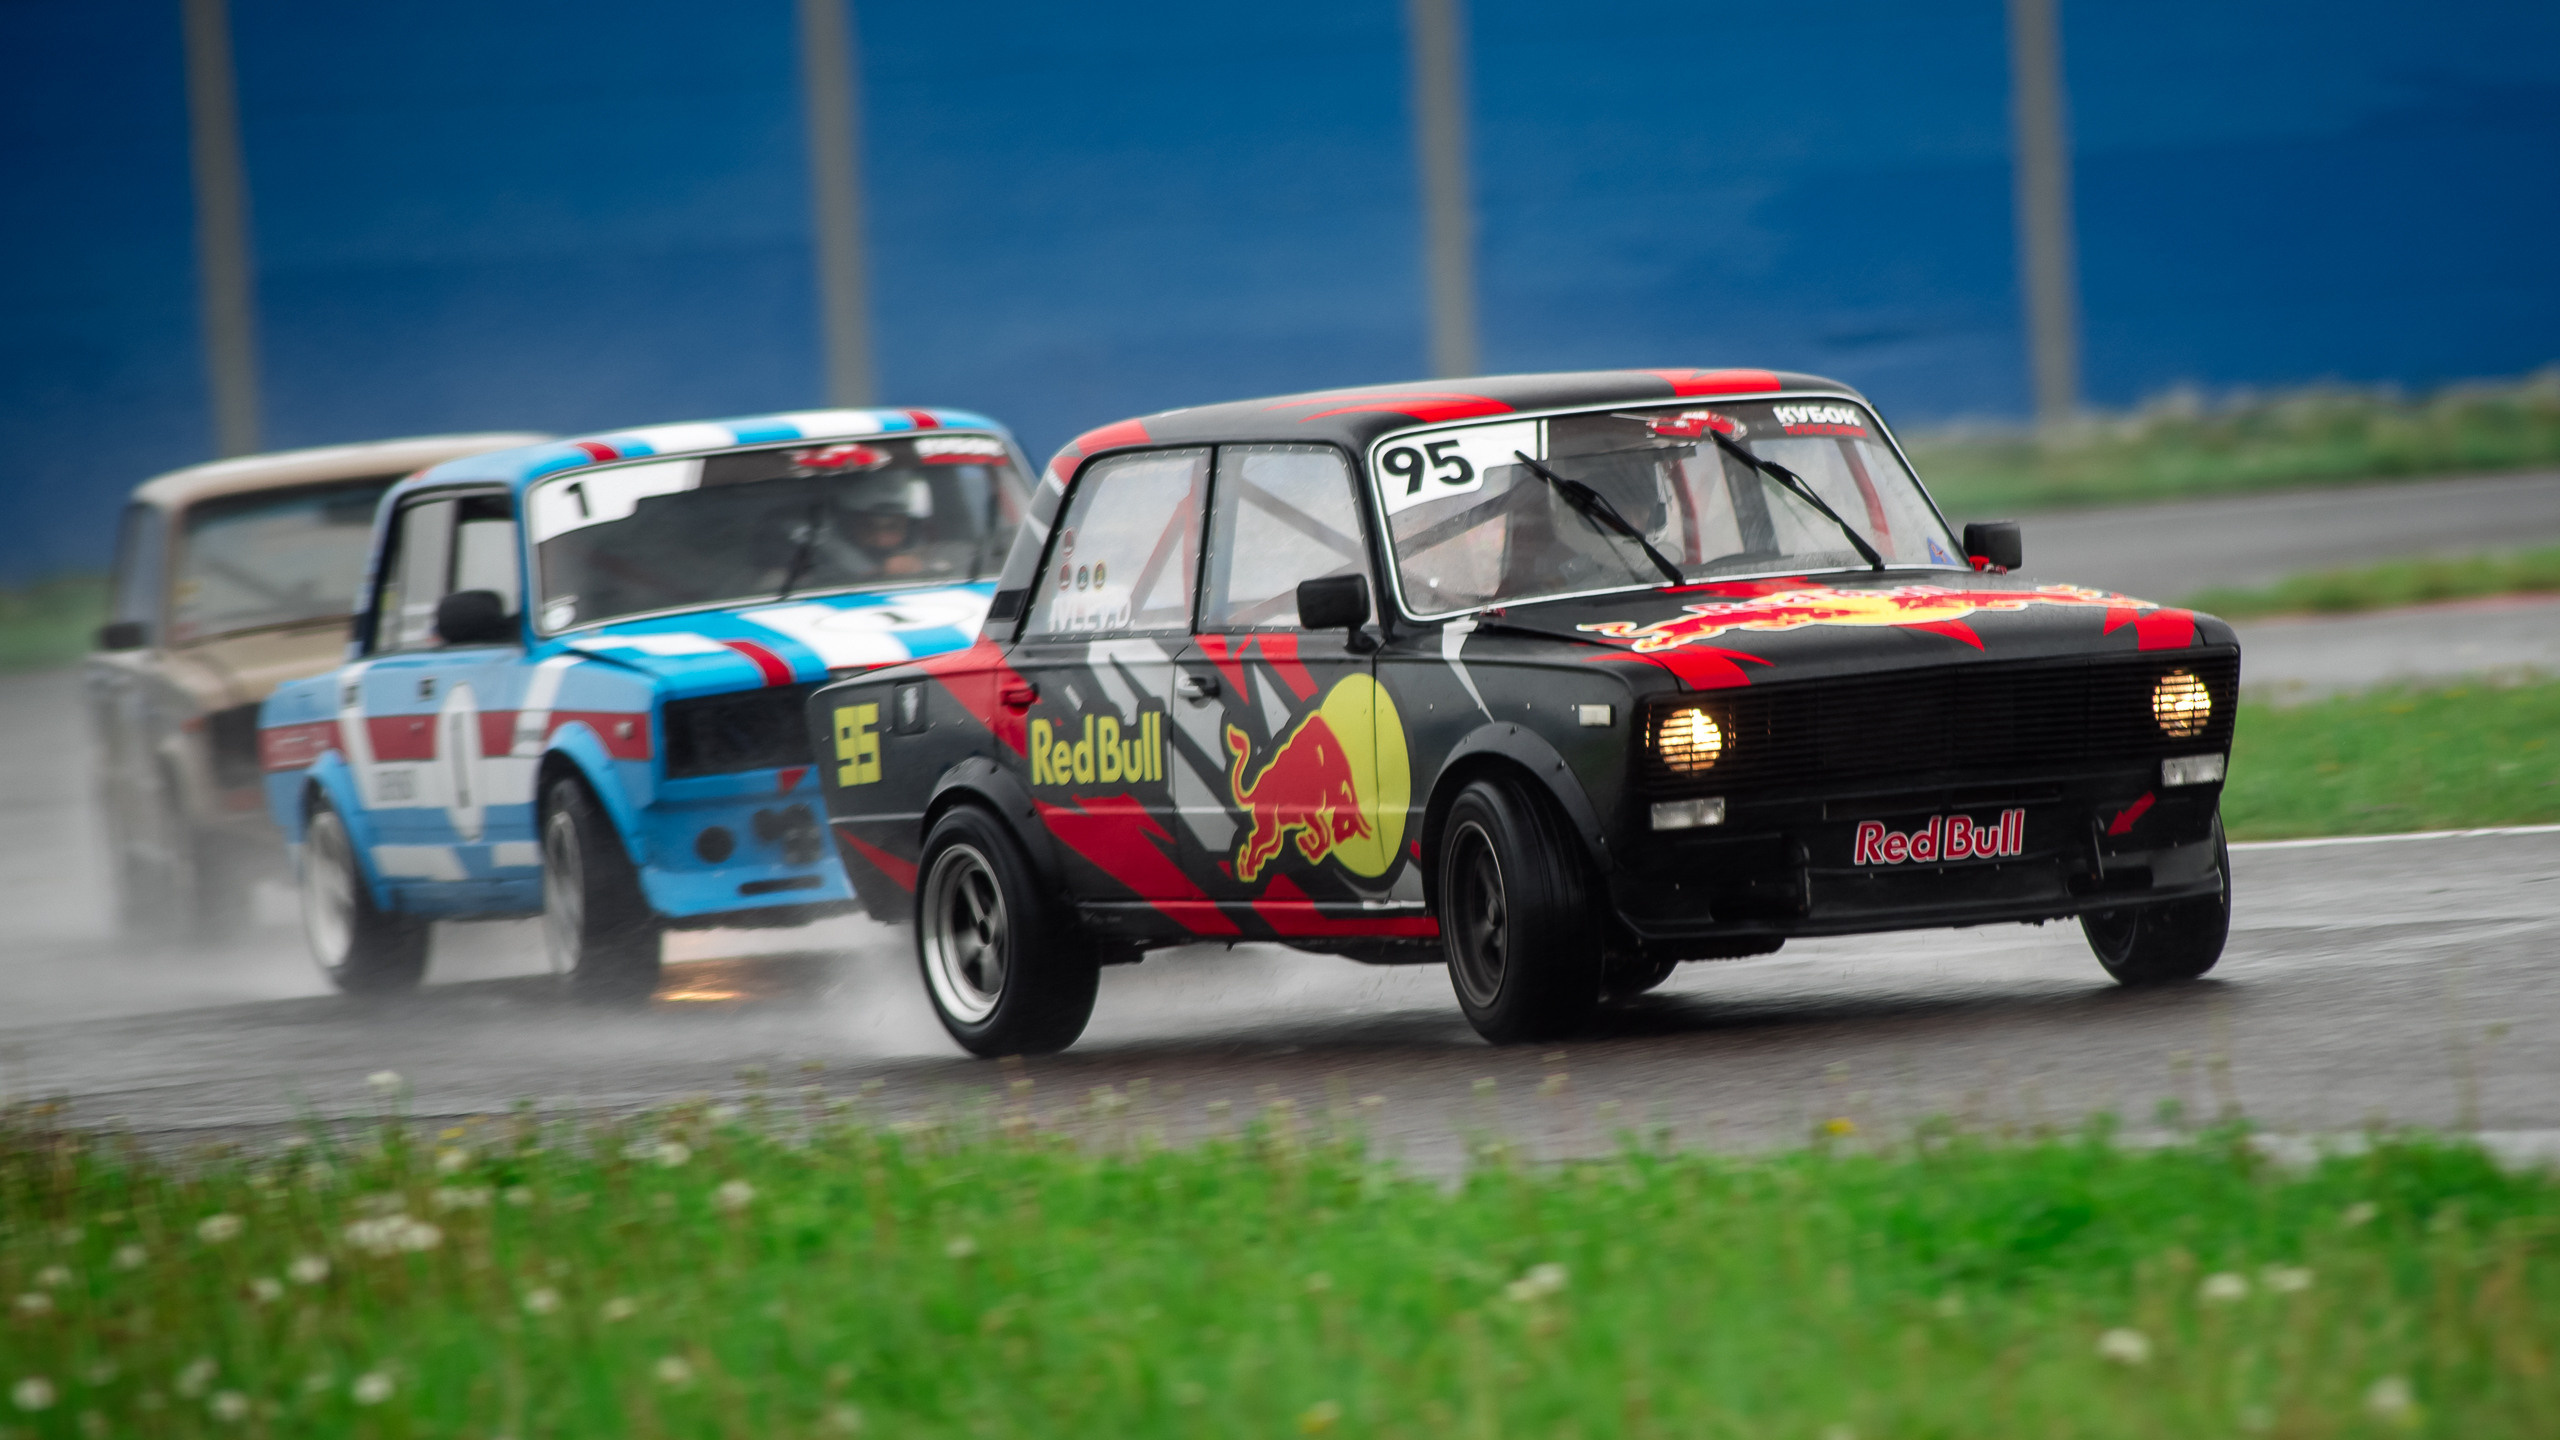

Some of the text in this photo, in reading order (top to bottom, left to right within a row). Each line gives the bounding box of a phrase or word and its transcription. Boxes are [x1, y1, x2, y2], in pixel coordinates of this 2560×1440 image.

[1773, 406, 1862, 427] КУБОК
[1382, 439, 1475, 496] 95
[566, 481, 591, 519] 1
[834, 703, 882, 788] 95
[1031, 711, 1163, 786] Red Bull
[1854, 807, 2026, 865] Red Bull
